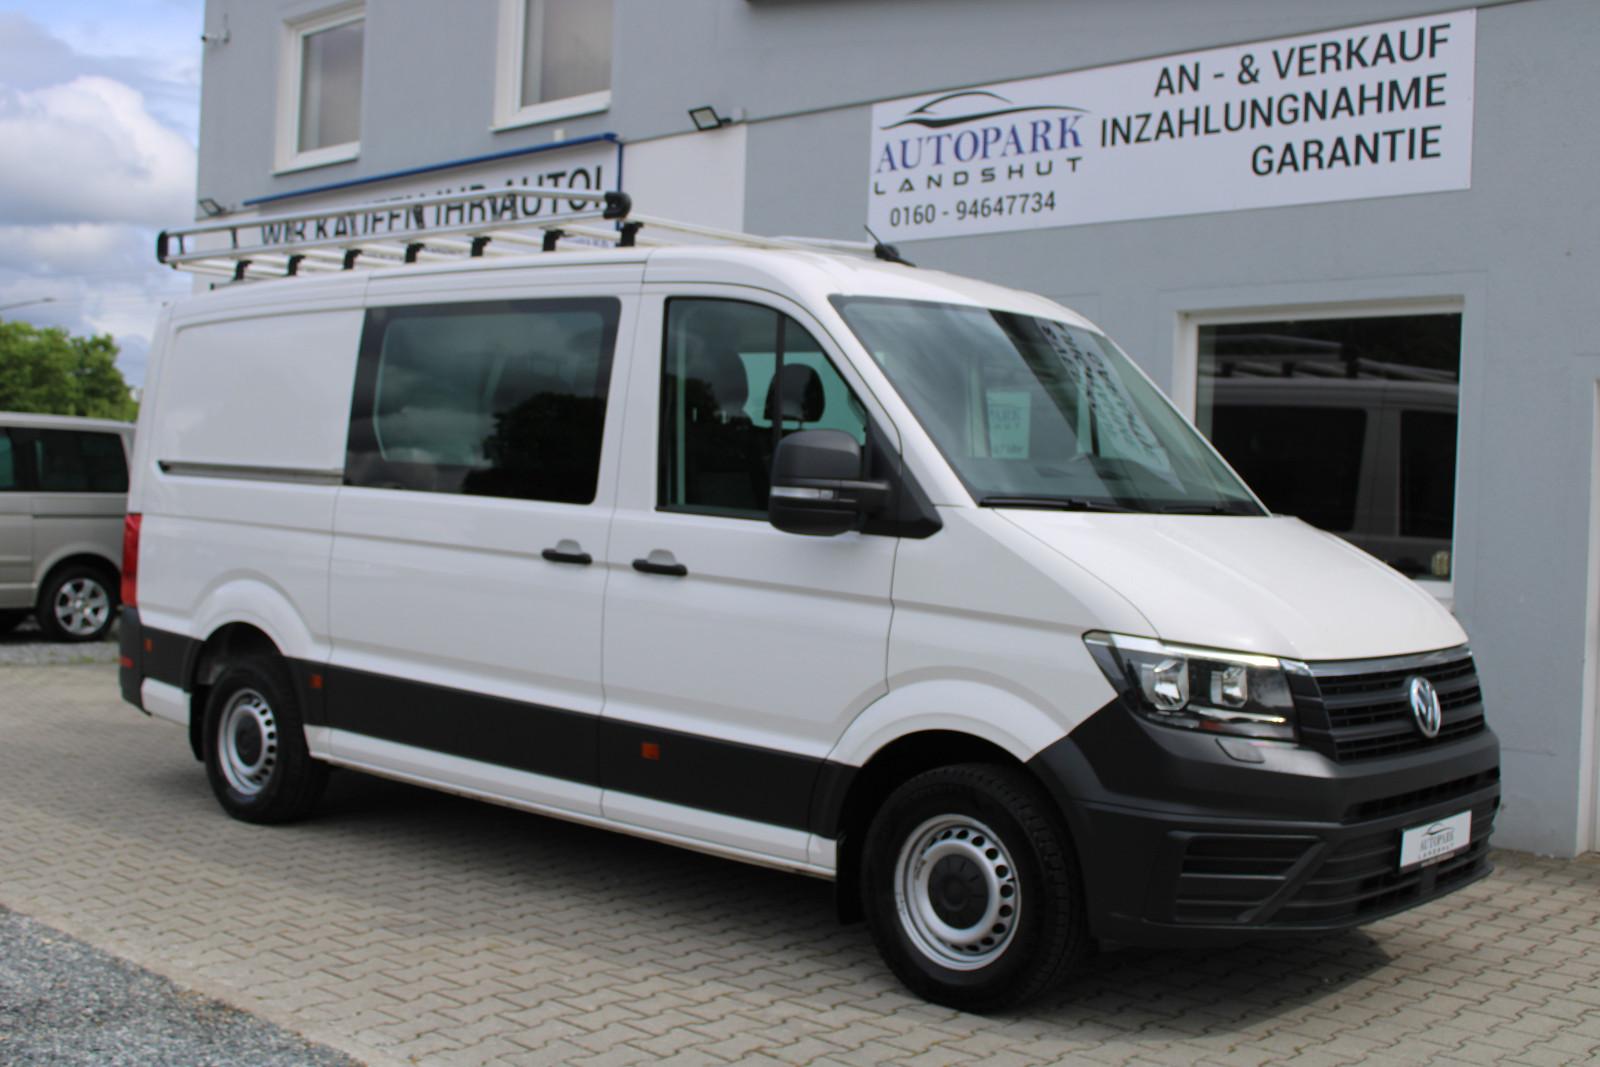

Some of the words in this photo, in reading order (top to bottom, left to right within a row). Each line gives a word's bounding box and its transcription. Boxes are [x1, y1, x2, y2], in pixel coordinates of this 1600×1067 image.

[1154, 62, 1200, 97] AN
[1237, 54, 1260, 86] &
[1272, 23, 1451, 79] VERKAUF
[1101, 73, 1447, 147] INZAHLUNGNAHME
[874, 114, 1084, 174] AUTOPARK
[1252, 125, 1442, 176] GARANTIE
[874, 156, 1083, 195] LANDSHUT
[890, 203, 936, 228] 0160
[956, 190, 1057, 221] 94647734
